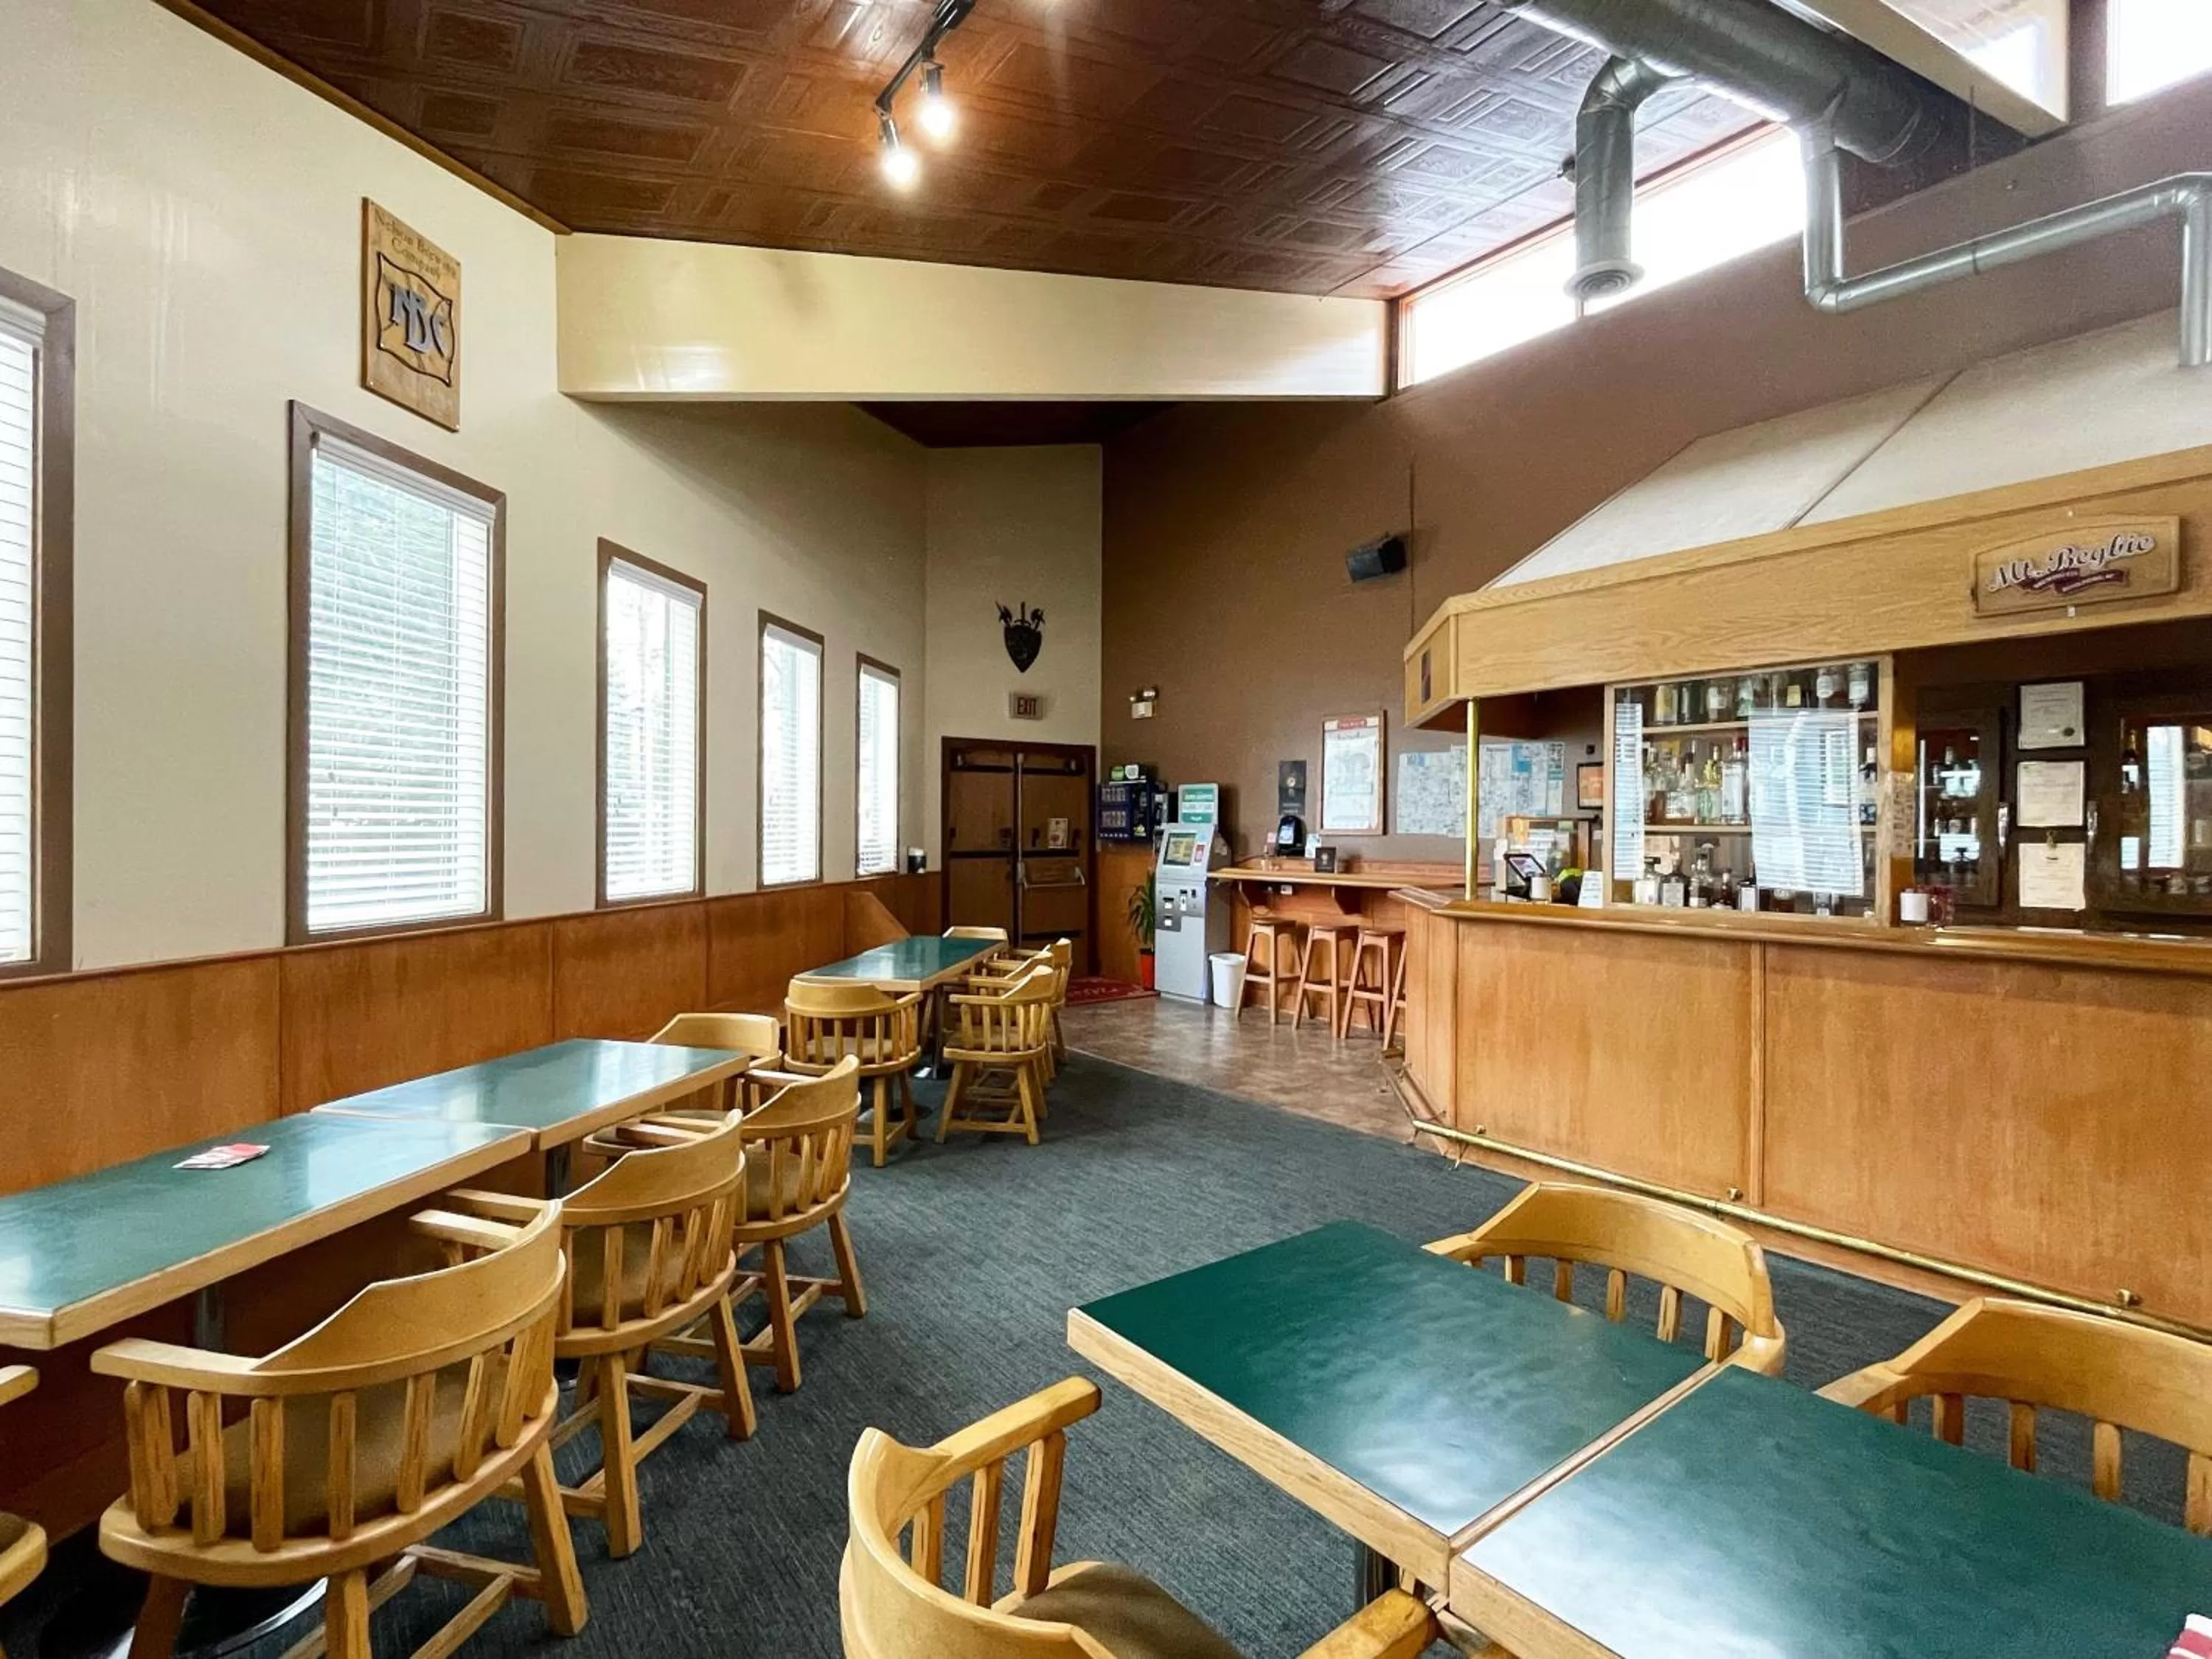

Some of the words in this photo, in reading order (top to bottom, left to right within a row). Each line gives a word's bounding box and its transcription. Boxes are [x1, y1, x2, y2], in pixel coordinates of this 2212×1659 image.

[392, 237, 440, 283] Company
[2048, 533, 2155, 571] Begbie
[1017, 697, 1037, 717] EXIT
